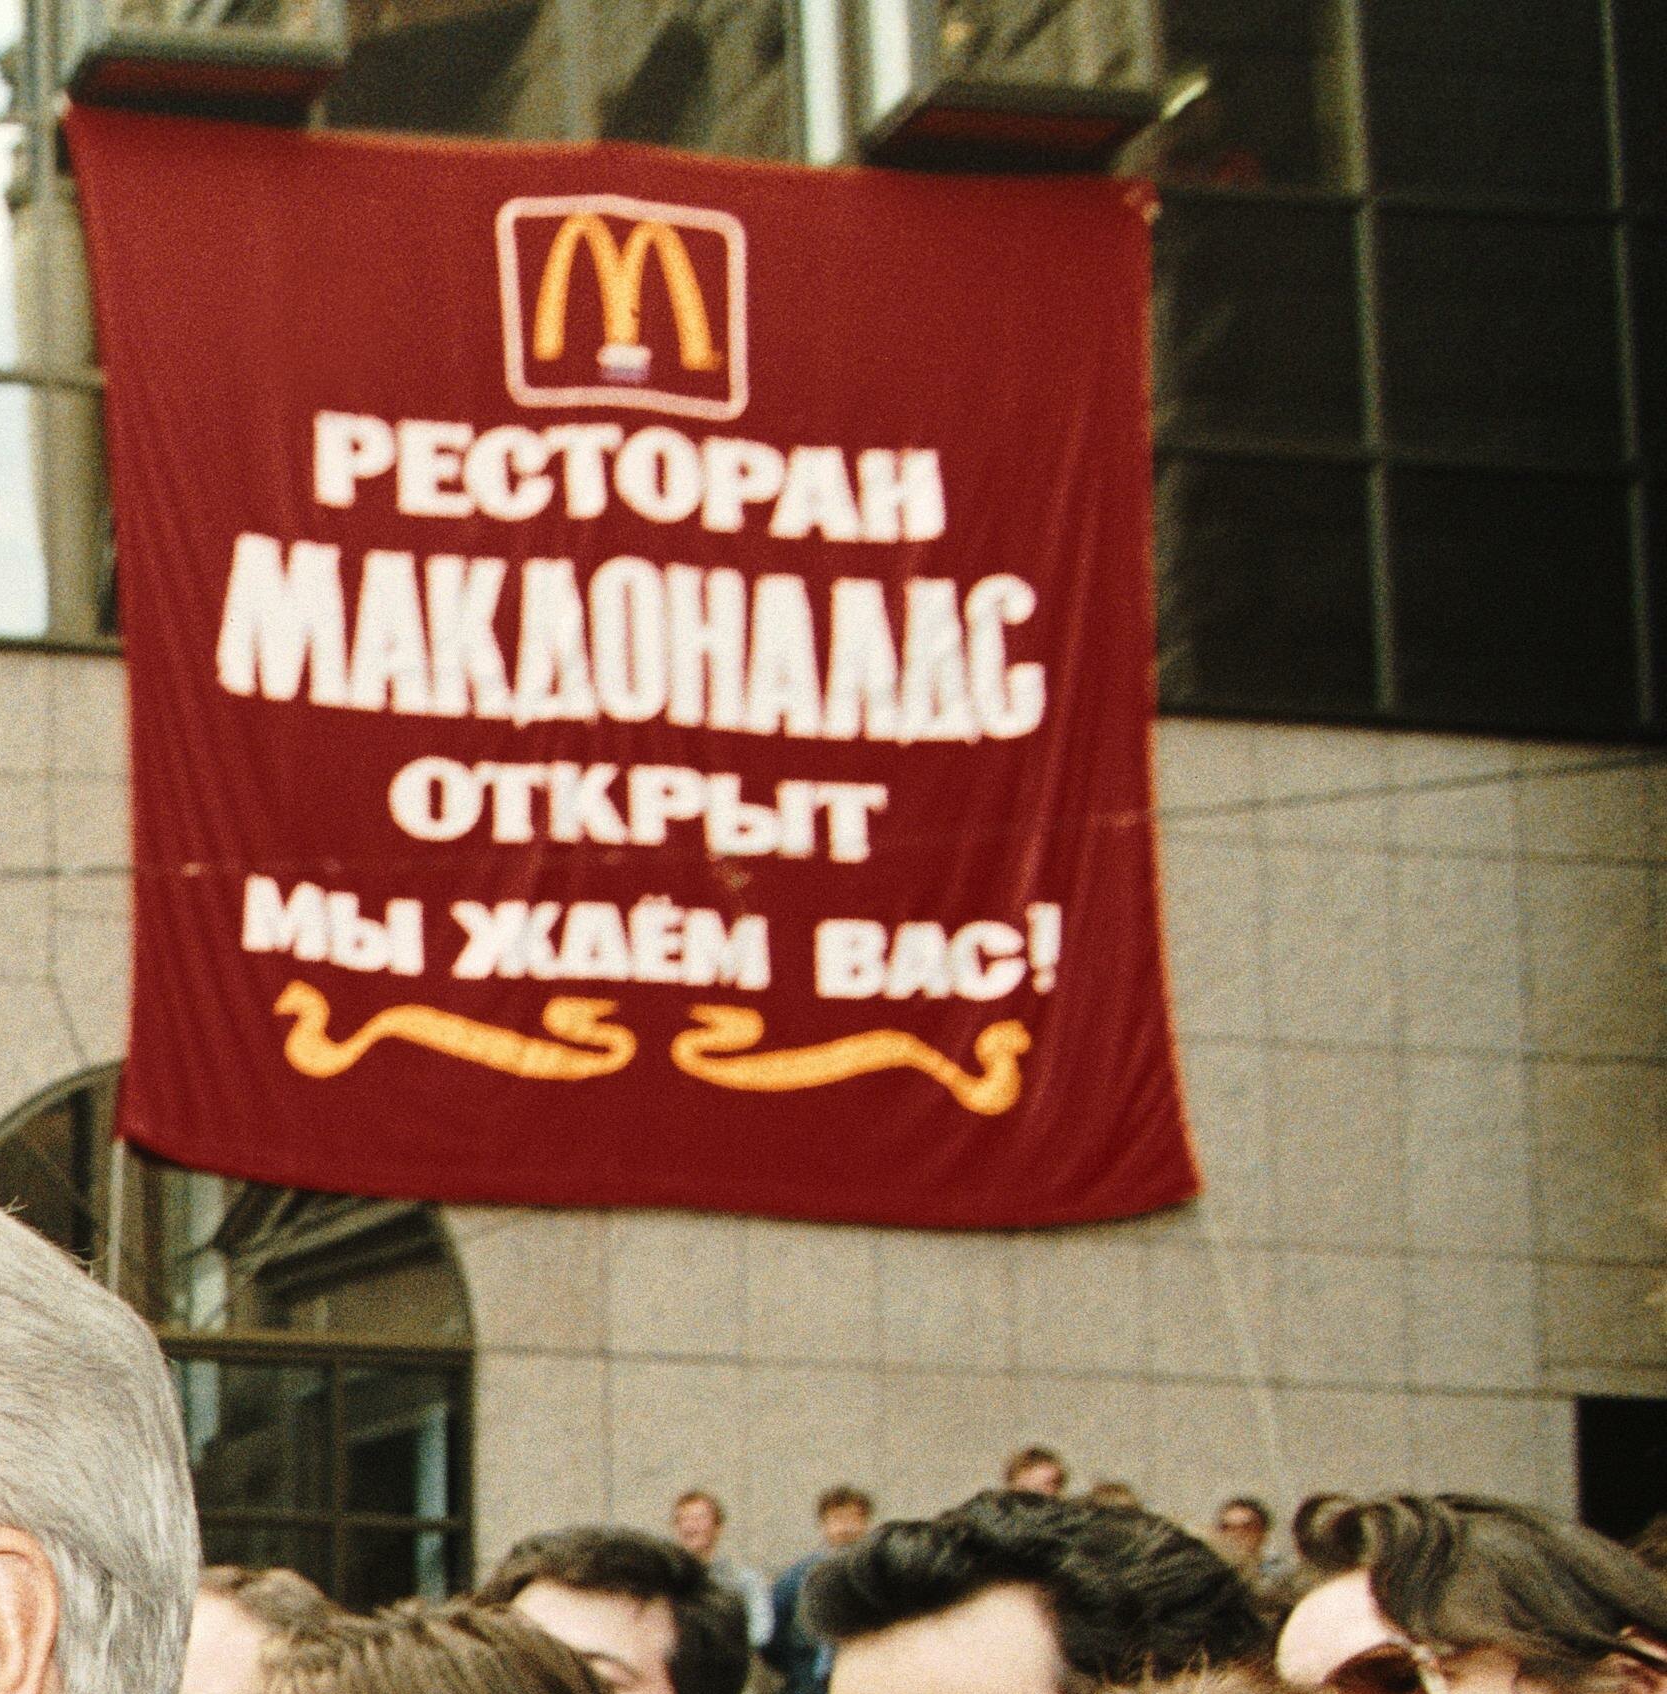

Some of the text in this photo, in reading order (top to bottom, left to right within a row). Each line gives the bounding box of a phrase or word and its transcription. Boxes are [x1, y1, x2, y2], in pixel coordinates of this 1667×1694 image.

[312, 410, 946, 543] РЕСТОРАН
[215, 532, 1046, 745] МАКДОНАЛДС
[388, 756, 888, 863] ОТКРЫТ
[241, 875, 1062, 1002] МЫ ЖДЁМ ВАС!
